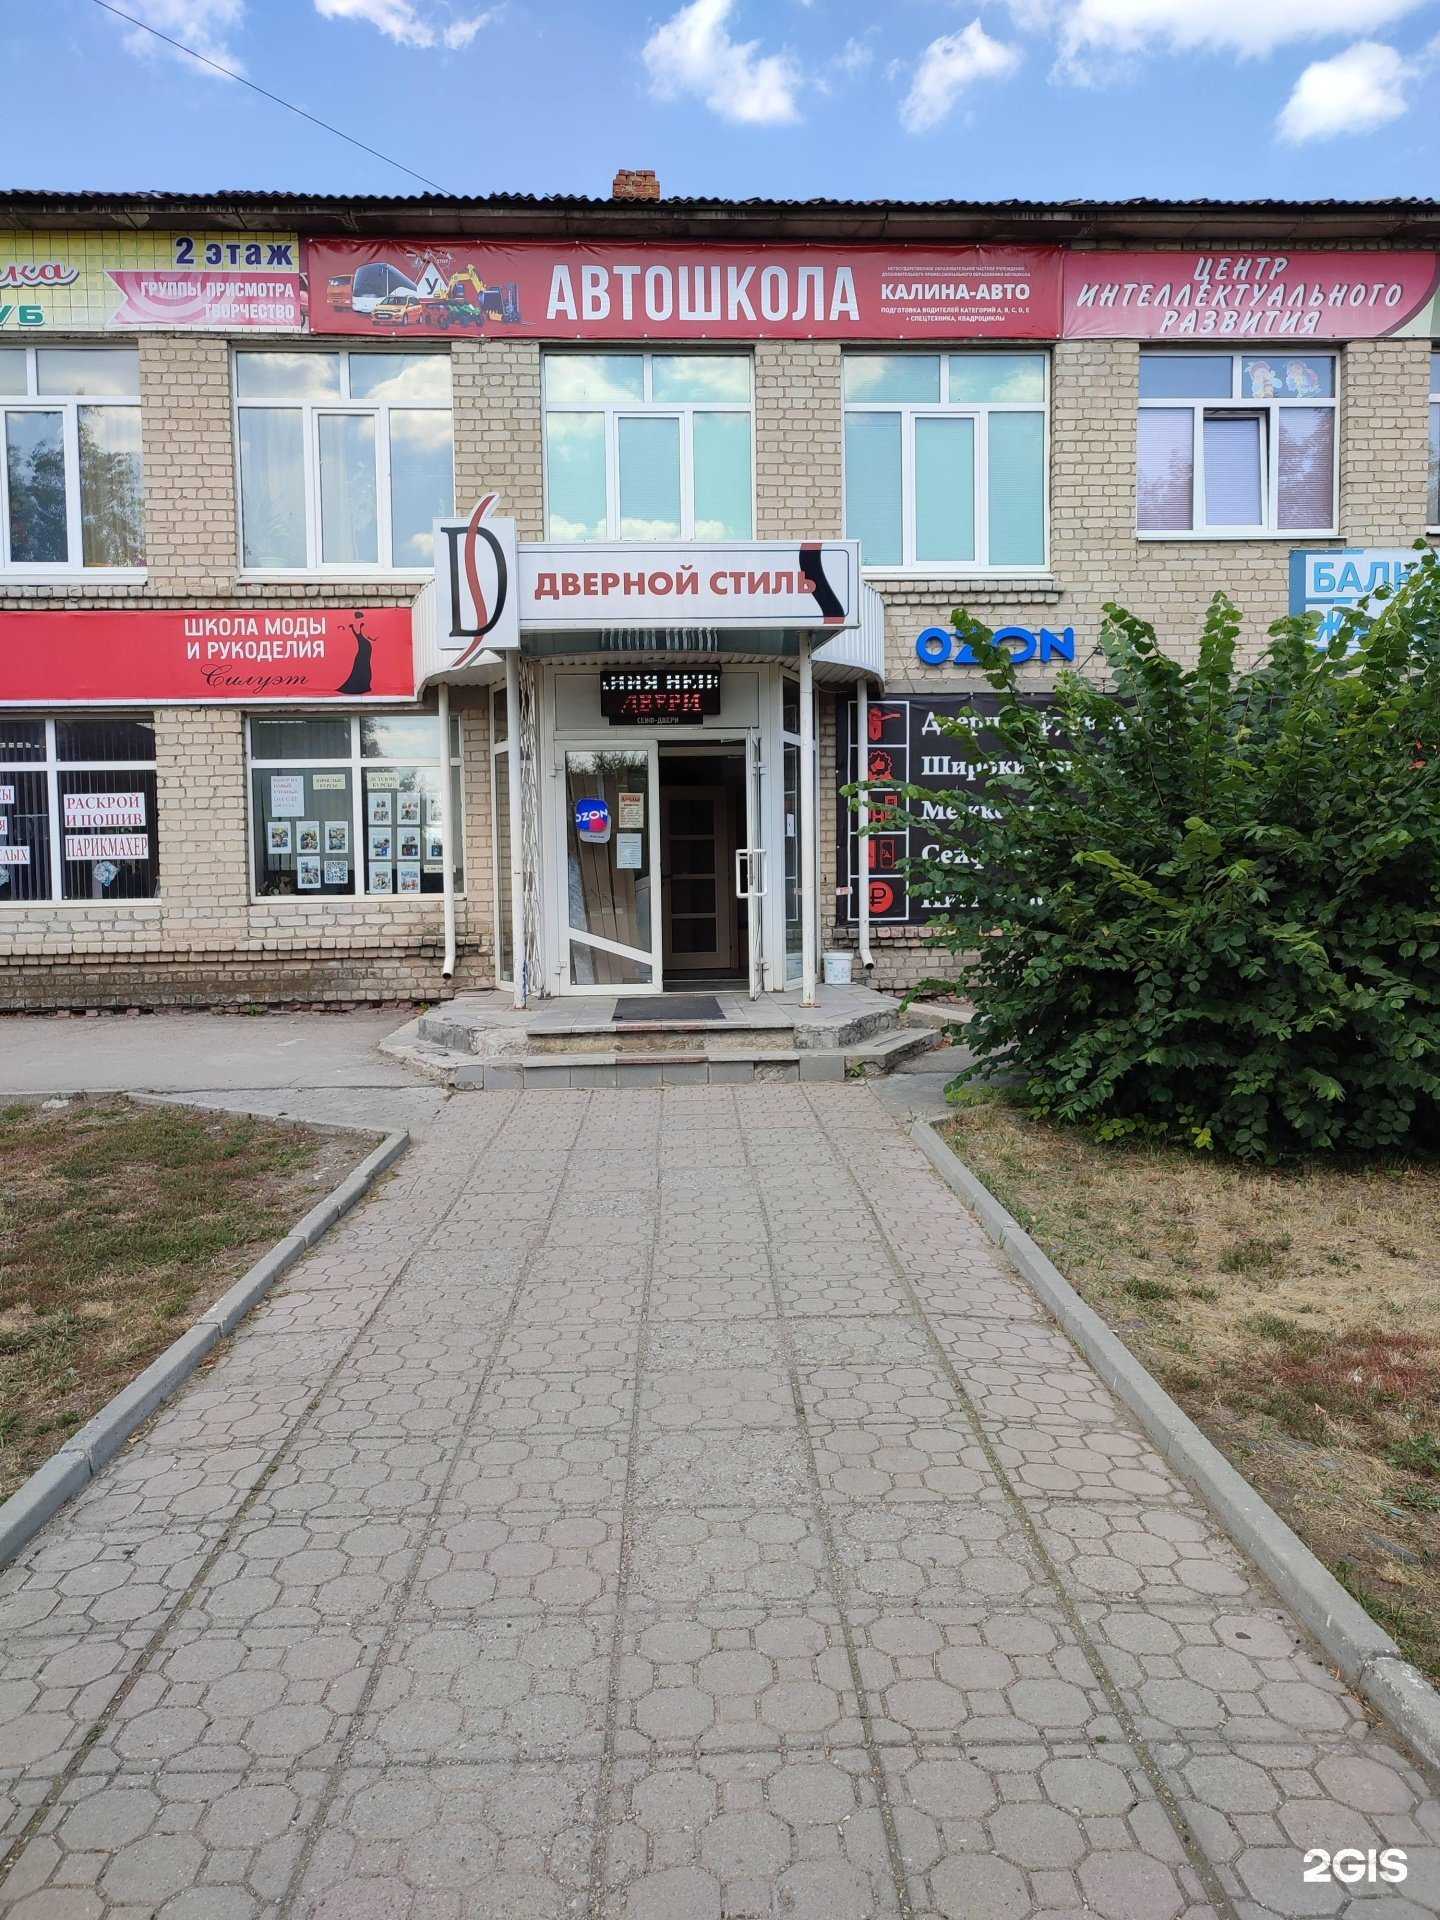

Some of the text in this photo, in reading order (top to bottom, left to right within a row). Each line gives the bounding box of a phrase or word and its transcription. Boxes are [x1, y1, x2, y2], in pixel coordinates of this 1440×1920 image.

[176, 237, 293, 265] 2 этаж
[1194, 257, 1289, 288] ЦЕНТР
[140, 281, 294, 297] ГРУППЫ ПРИСМОТРА
[547, 264, 860, 321] АВТОШКОЛА
[881, 283, 1030, 300] КАЛИНА-АВТО
[1076, 283, 1404, 308] ИНТЕЛЛЕКТУАЛЬНОГО
[204, 303, 294, 319] ТВОРЧЕСТВО
[1159, 309, 1322, 335] РАЗВИТИЯ
[534, 565, 817, 600] ДВЕРНОЙ СТИЛЬ
[184, 617, 327, 639] ШКОЛА МОДЫ
[187, 641, 326, 662] И РУКОДЕЛИЯ
[200, 664, 307, 694] Силуэт
[67, 793, 140, 810] РАСКРОЙ
[66, 814, 143, 827] И ПОШИВ
[576, 808, 609, 823] OZON
[66, 837, 148, 857] ПАРИКМАХЕР
